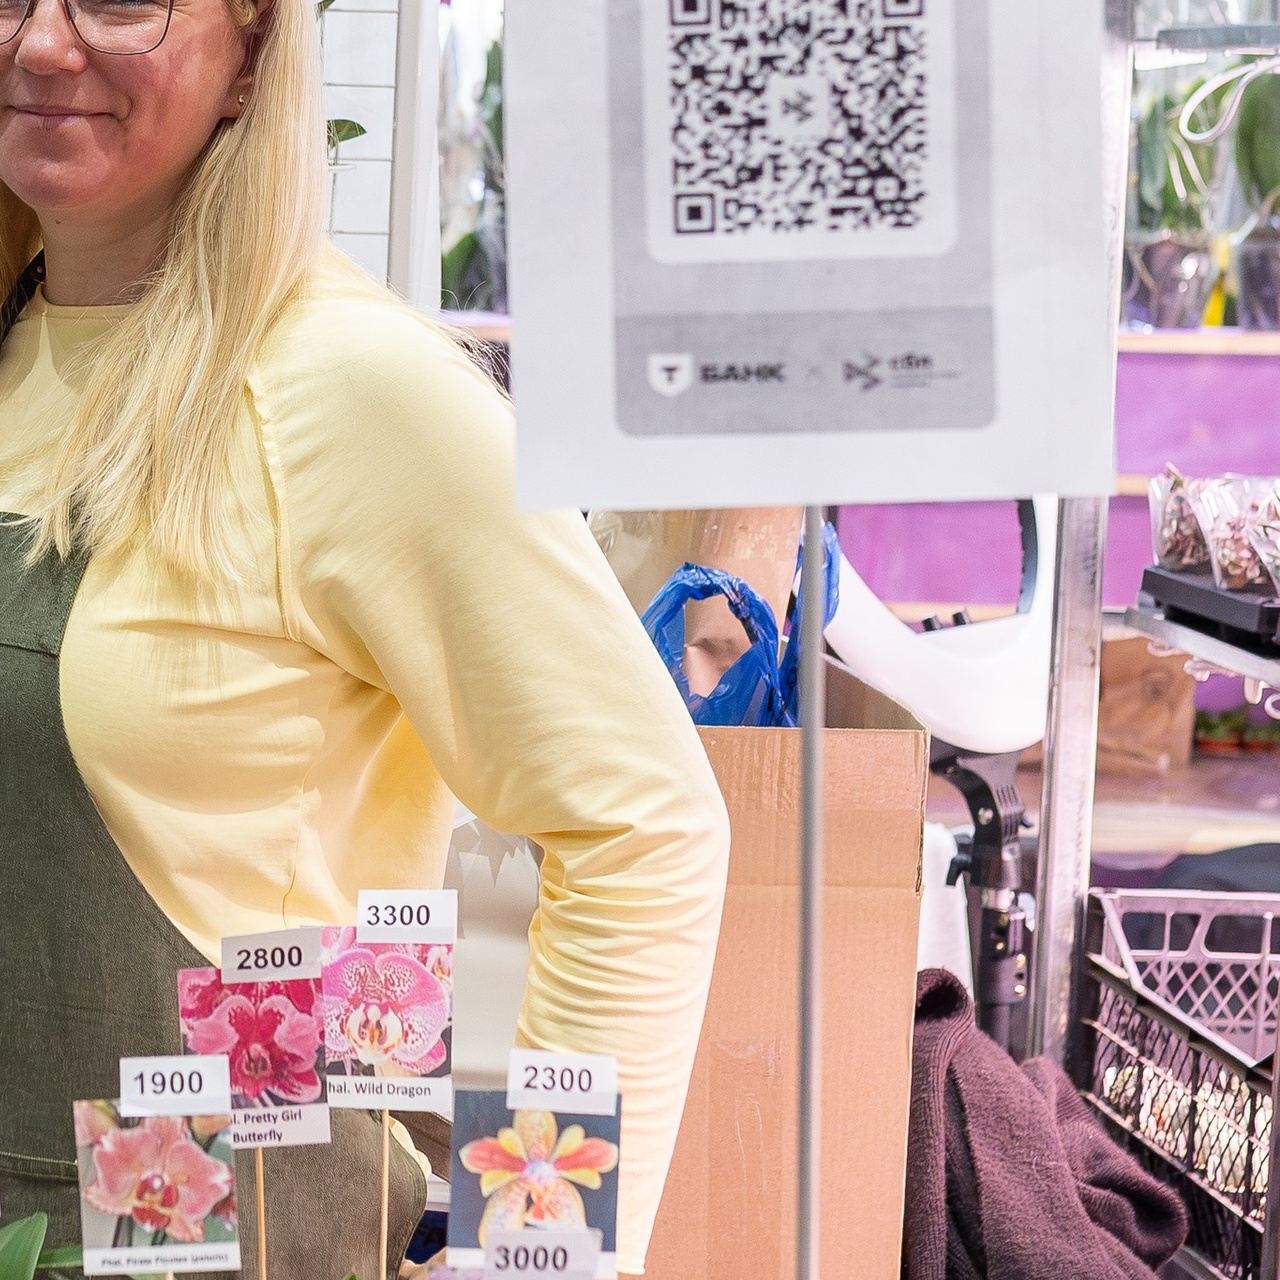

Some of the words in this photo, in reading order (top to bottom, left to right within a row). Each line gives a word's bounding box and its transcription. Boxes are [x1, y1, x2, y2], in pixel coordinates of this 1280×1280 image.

[699, 362, 784, 384] БАНК
[367, 905, 430, 926] 3300
[237, 946, 302, 970] 2800
[134, 1070, 203, 1095] 1900
[524, 1066, 593, 1092] 2300
[327, 1081, 351, 1096] hal.
[354, 1082, 383, 1096] Wild
[386, 1083, 432, 1101] Dragon
[244, 1110, 278, 1128] Pretty
[281, 1108, 302, 1122] Girl
[232, 1129, 283, 1145] Butterfly
[495, 1246, 568, 1272] 3000
